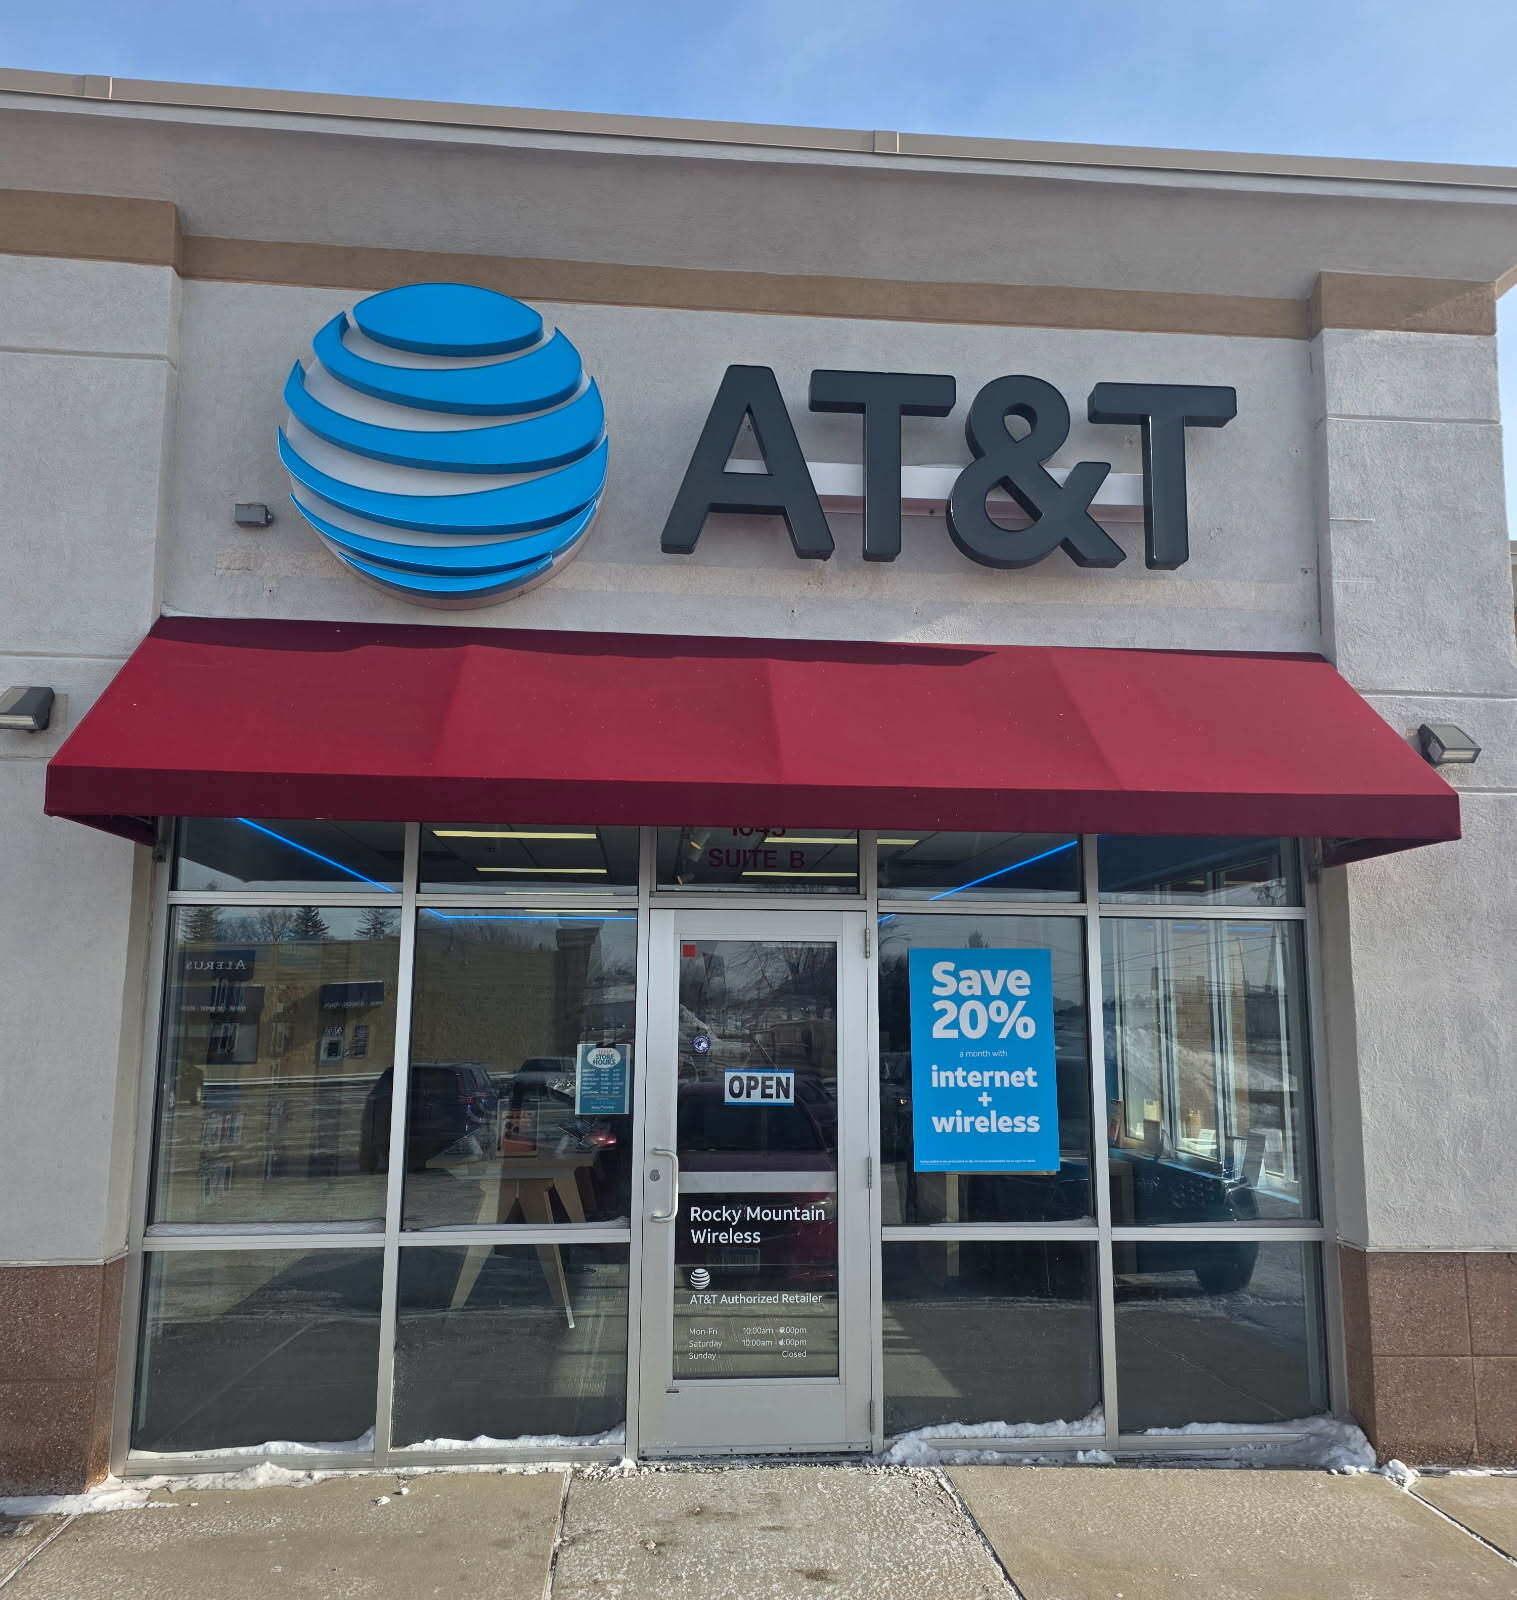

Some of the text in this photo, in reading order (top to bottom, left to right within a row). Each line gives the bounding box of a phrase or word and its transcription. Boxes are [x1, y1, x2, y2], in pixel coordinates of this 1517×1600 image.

[660, 364, 1237, 570] AT&T
[708, 848, 805, 868] SUITE B
[931, 961, 1031, 997] Save
[931, 1000, 1036, 1039] 20%
[592, 1058, 616, 1066] HOURS
[965, 1050, 991, 1058] month
[991, 1050, 1008, 1058] with
[931, 1065, 1038, 1088] internet
[728, 1075, 791, 1099] OPEN
[978, 1091, 992, 1107] +
[931, 1110, 1041, 1133] wireless
[689, 1205, 825, 1225] Rocky Mountain
[690, 1228, 761, 1244] Wireless
[689, 1293, 823, 1305] AT&T Authorized Retailer
[688, 1327, 719, 1336] Mon-Fri
[688, 1339, 723, 1349] Saturday
[688, 1350, 807, 1361] Sunday Closed
